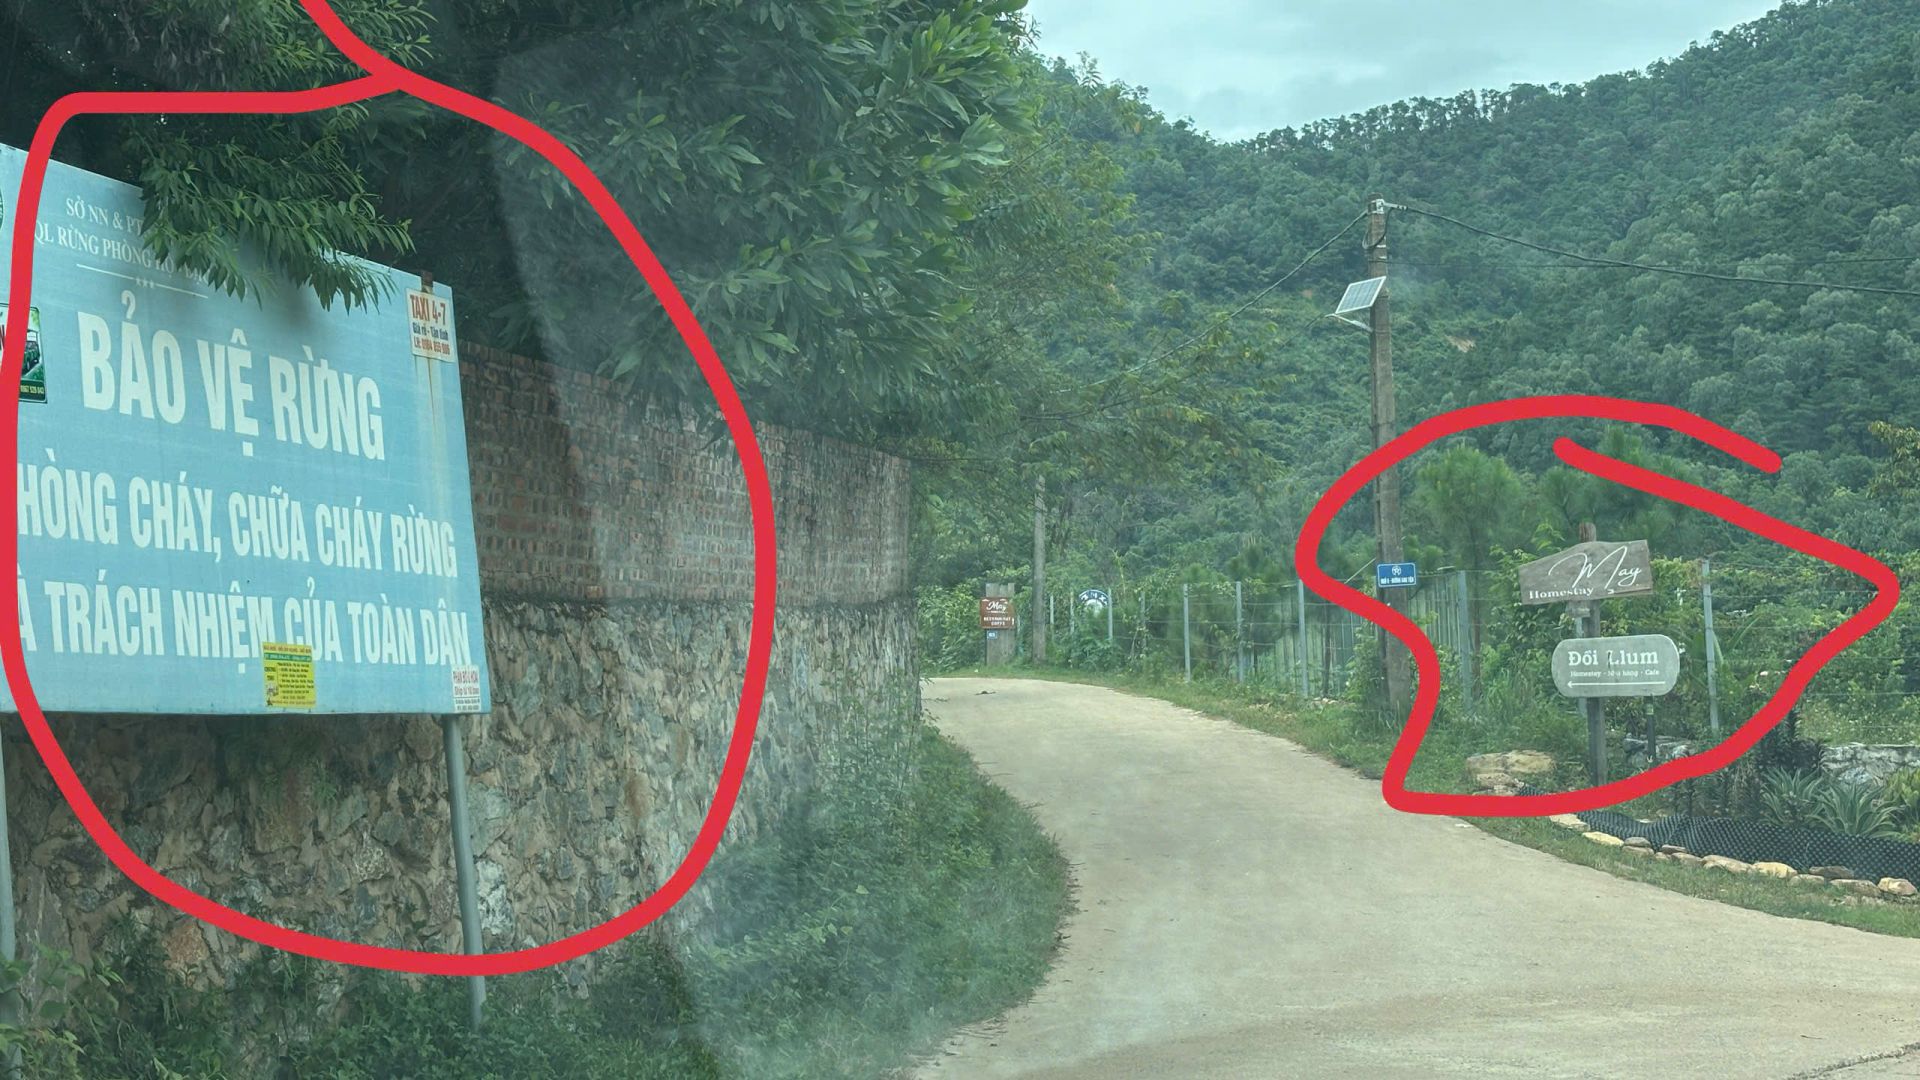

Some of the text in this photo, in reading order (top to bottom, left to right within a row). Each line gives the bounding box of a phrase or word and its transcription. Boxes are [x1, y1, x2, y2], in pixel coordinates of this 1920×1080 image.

[66, 195, 85, 219] SỞ
[89, 205, 109, 227] NN
[112, 211, 123, 230] &
[57, 225, 99, 255] RỪNG
[102, 238, 151, 268] PHÒNG
[409, 294, 430, 321] TAXI
[78, 290, 385, 460] BẢO VỆ RỪNG
[17, 448, 458, 578] HÒNG CHÁY, CHỮA CHÁY RỪNG
[1548, 546, 1642, 589] May
[1529, 587, 1594, 600] Homestay
[17, 562, 472, 674] À TRÁCH NHIỆM CỦA TOÀN DÂN
[1568, 650, 1599, 666] Đồi
